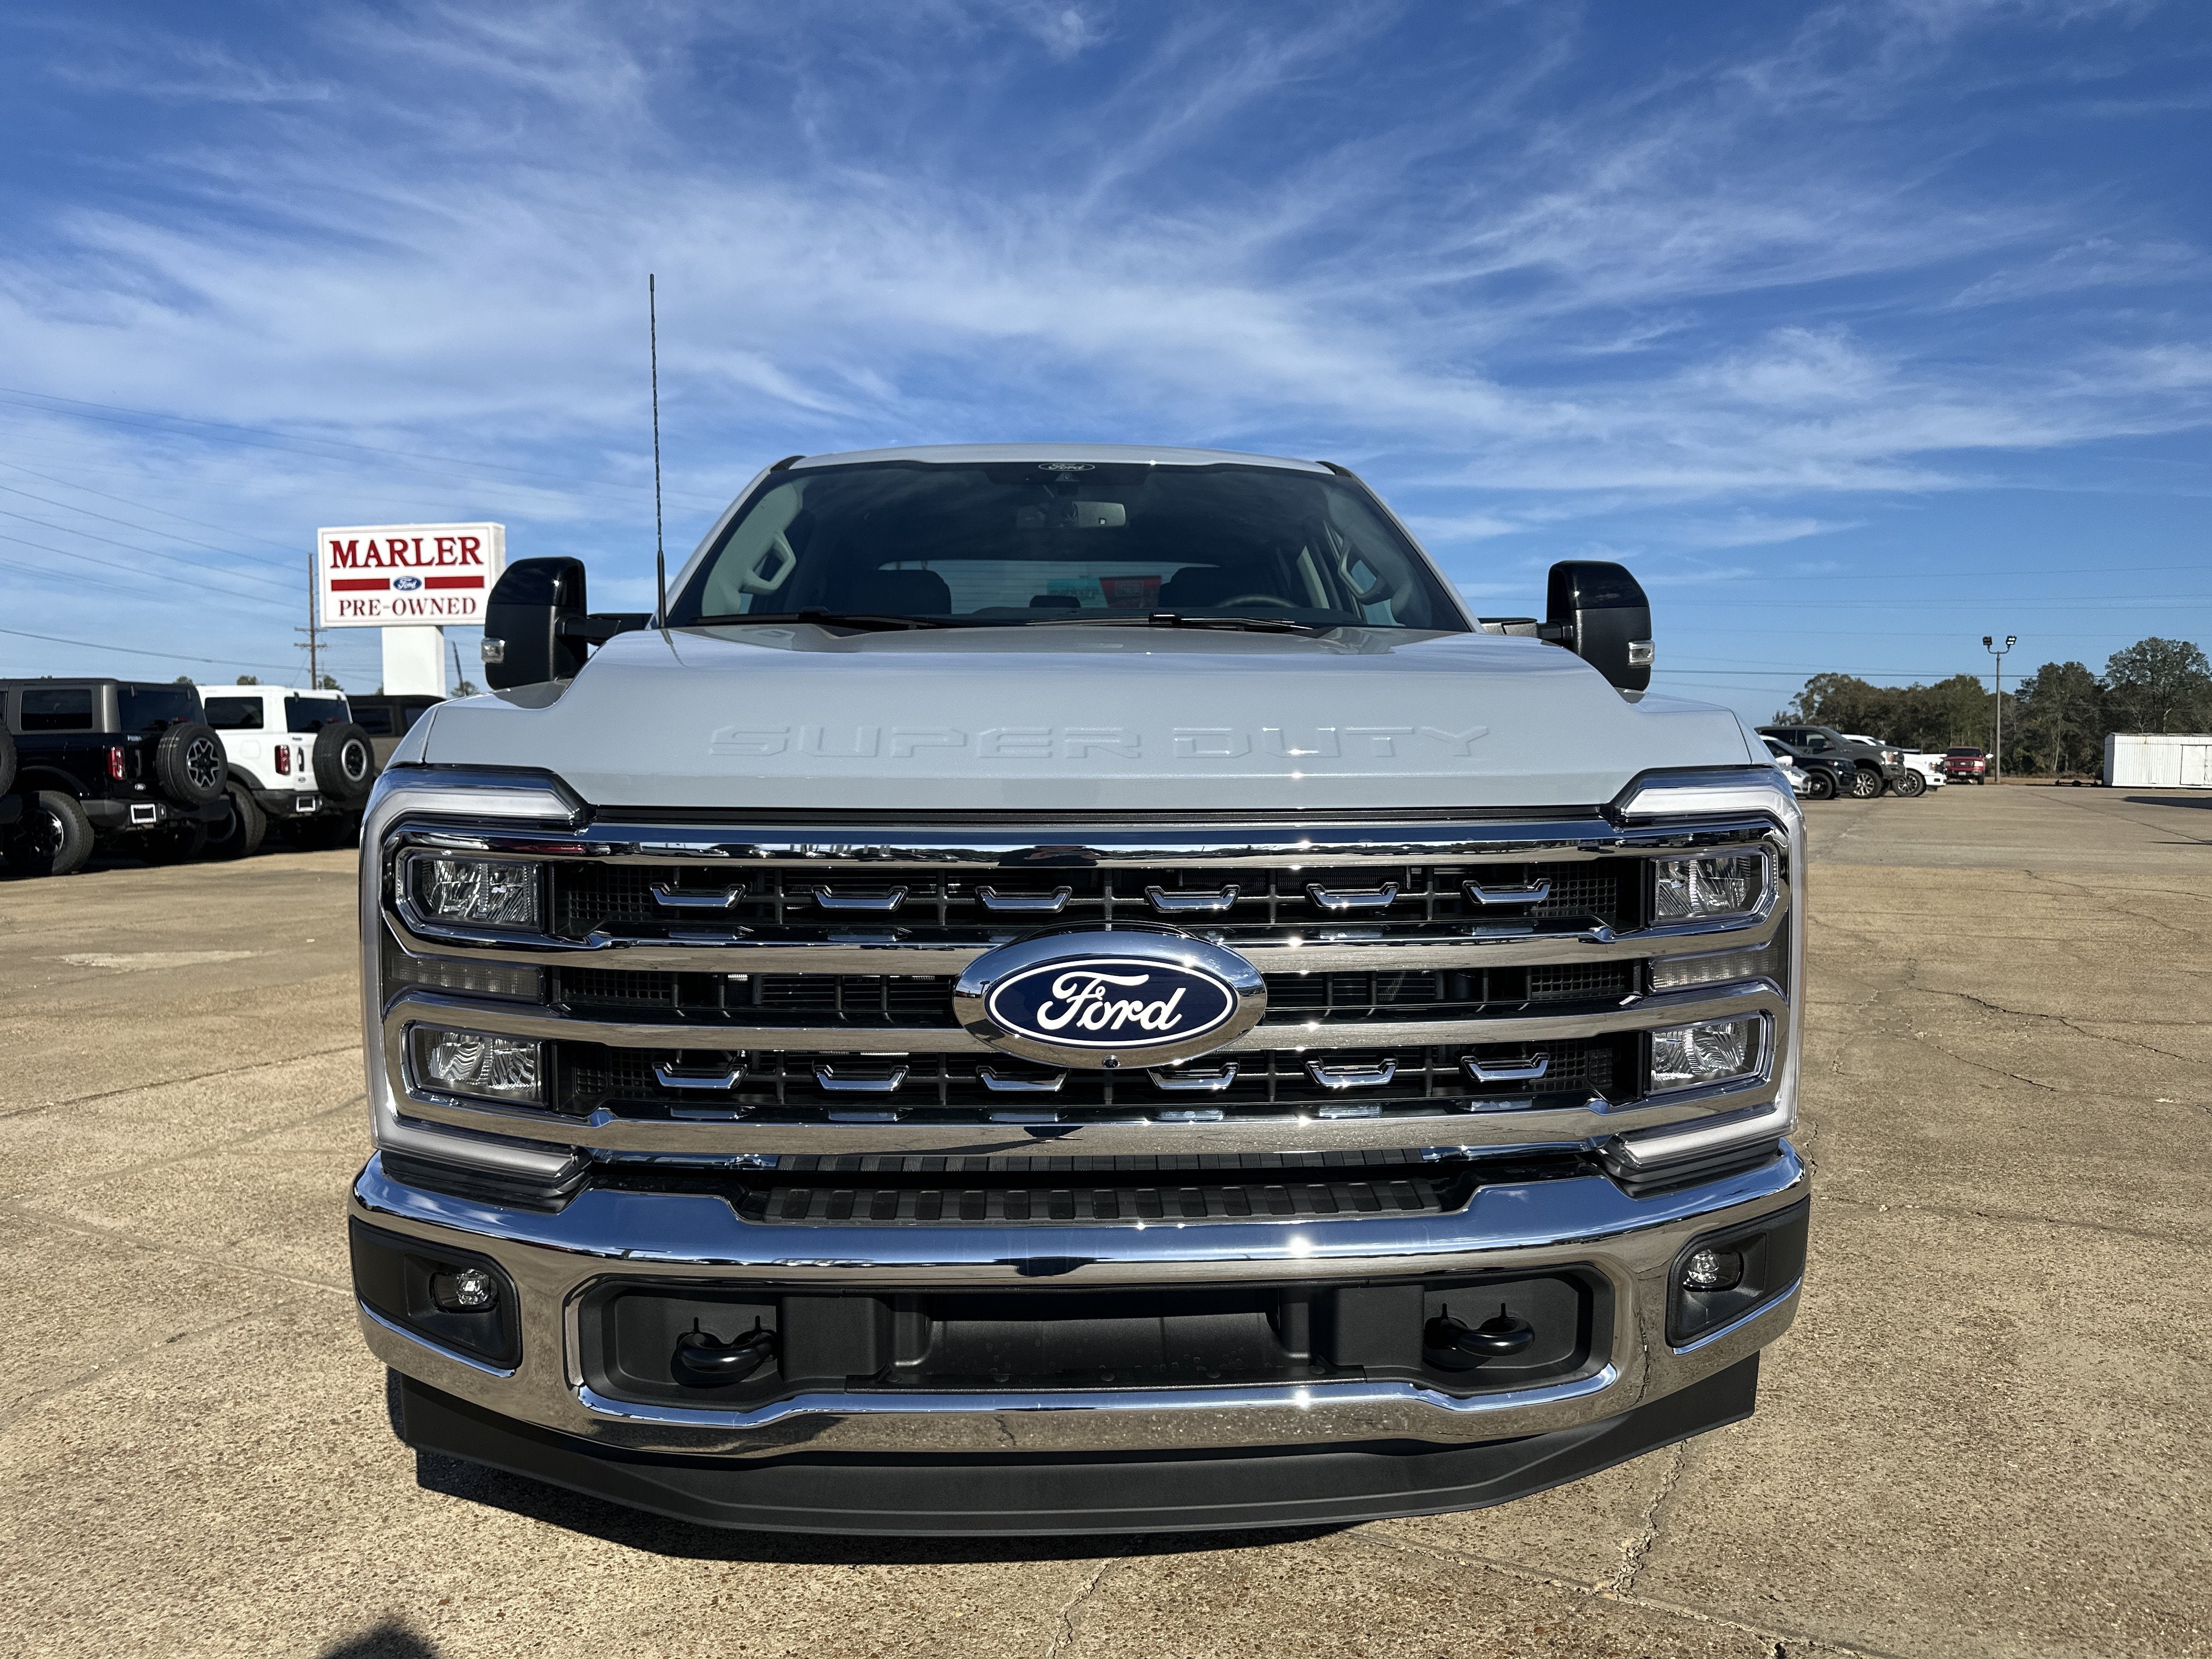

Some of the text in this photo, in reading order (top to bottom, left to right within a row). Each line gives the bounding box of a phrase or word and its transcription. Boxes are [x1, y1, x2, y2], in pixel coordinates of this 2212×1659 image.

[329, 536, 483, 568] MARLER
[338, 596, 477, 617] PRE-OWNED
[708, 725, 1491, 759] SUPER DUTY
[1036, 971, 1187, 1031] Ford
